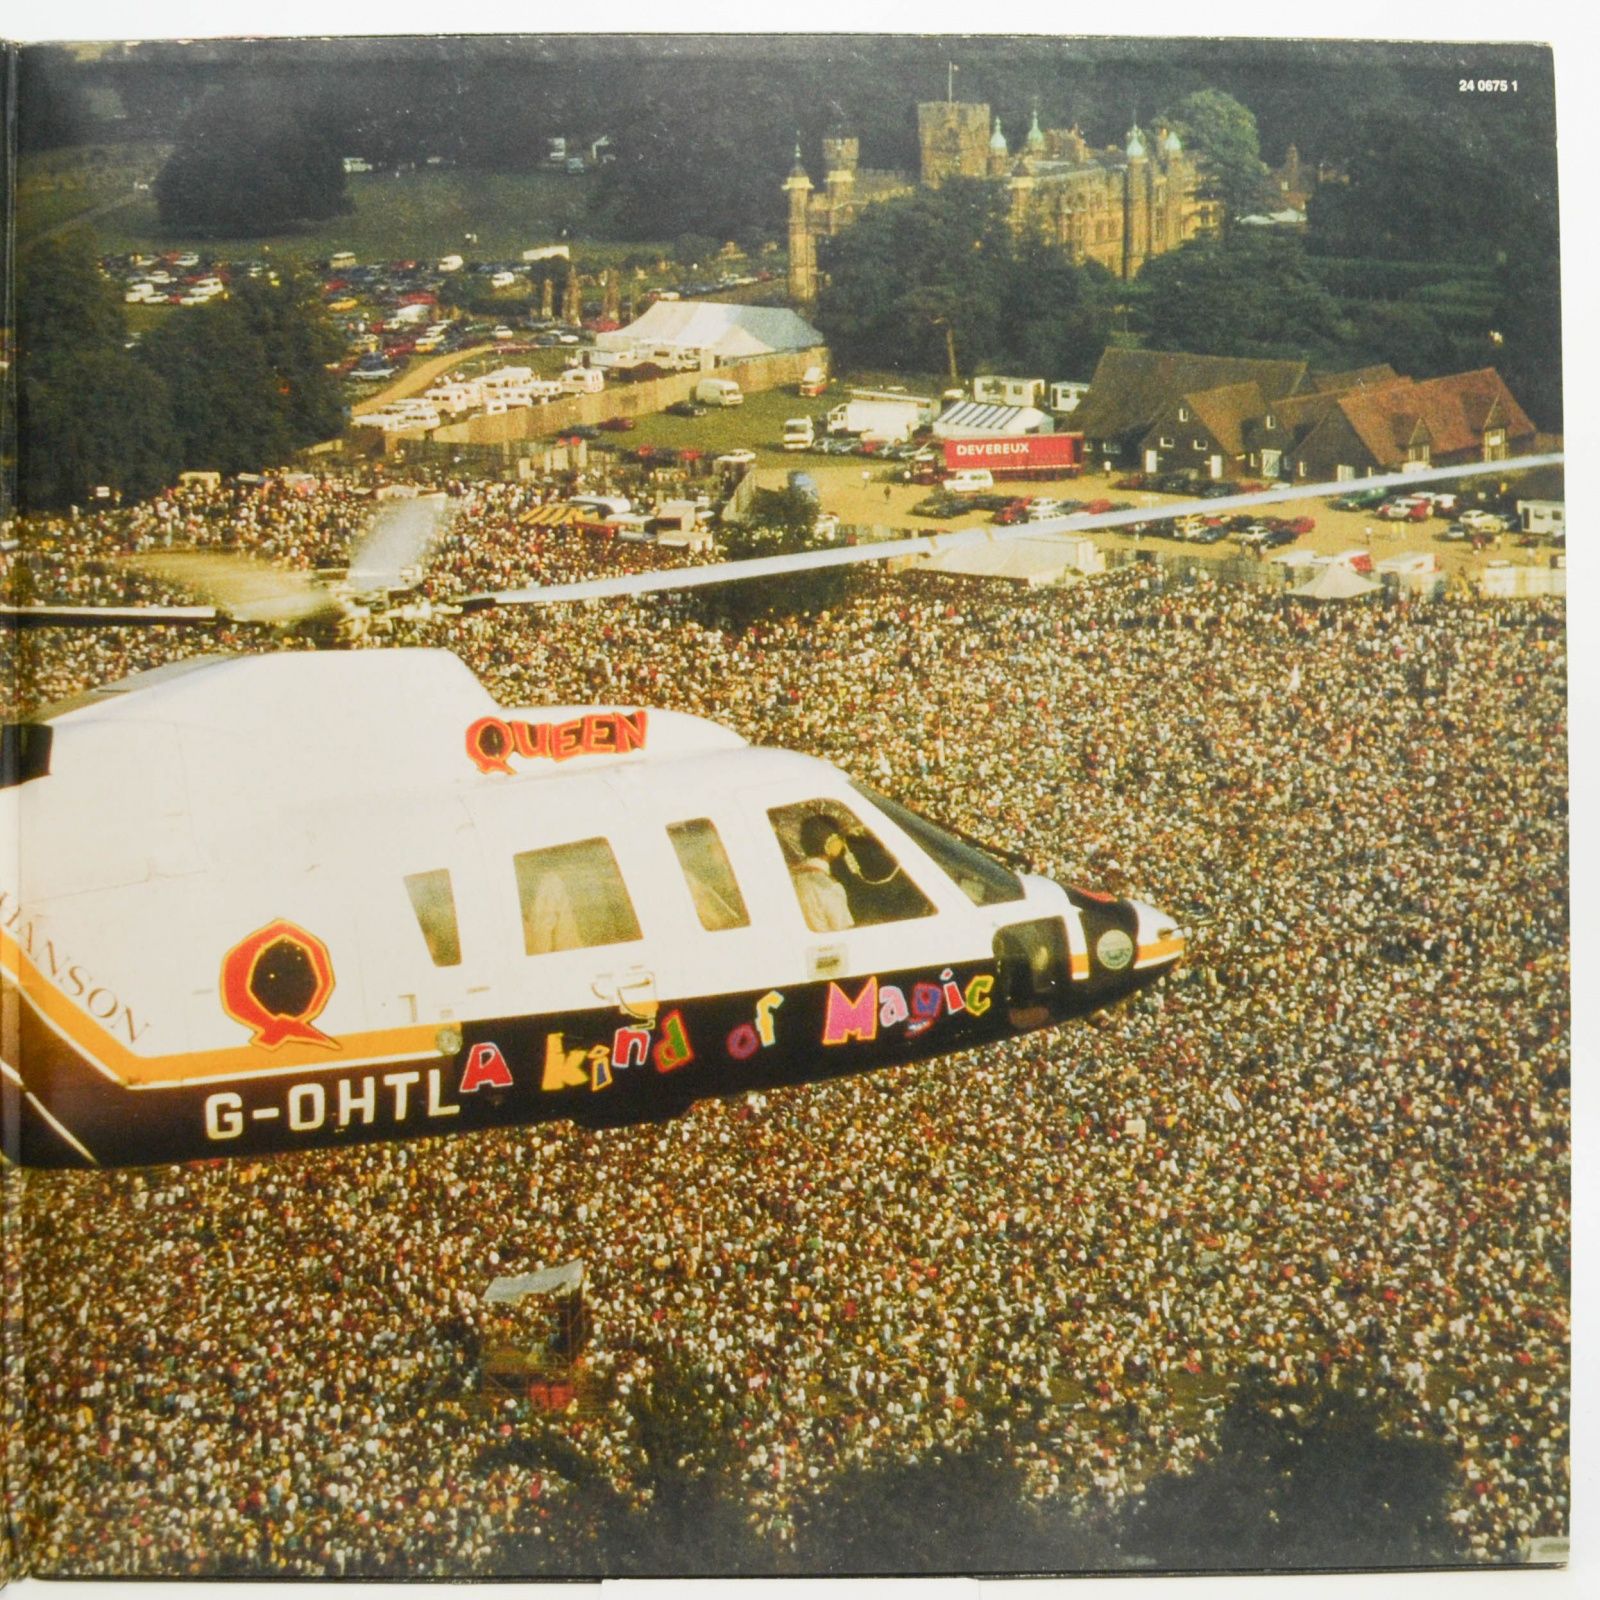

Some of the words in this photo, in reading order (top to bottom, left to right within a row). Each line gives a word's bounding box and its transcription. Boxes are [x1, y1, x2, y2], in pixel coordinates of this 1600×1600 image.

[1459, 79, 1475, 92] 24
[1477, 79, 1508, 92] 0675
[1511, 80, 1518, 92] 1
[956, 442, 1030, 456] DEVEREUX
[465, 710, 648, 775] QUEEN
[219, 918, 342, 1051] Q
[459, 1042, 513, 1092] A
[541, 1008, 695, 1092] kind
[726, 990, 785, 1060] of
[822, 967, 994, 1046] Magic
[205, 1069, 460, 1141] G-OHTL
